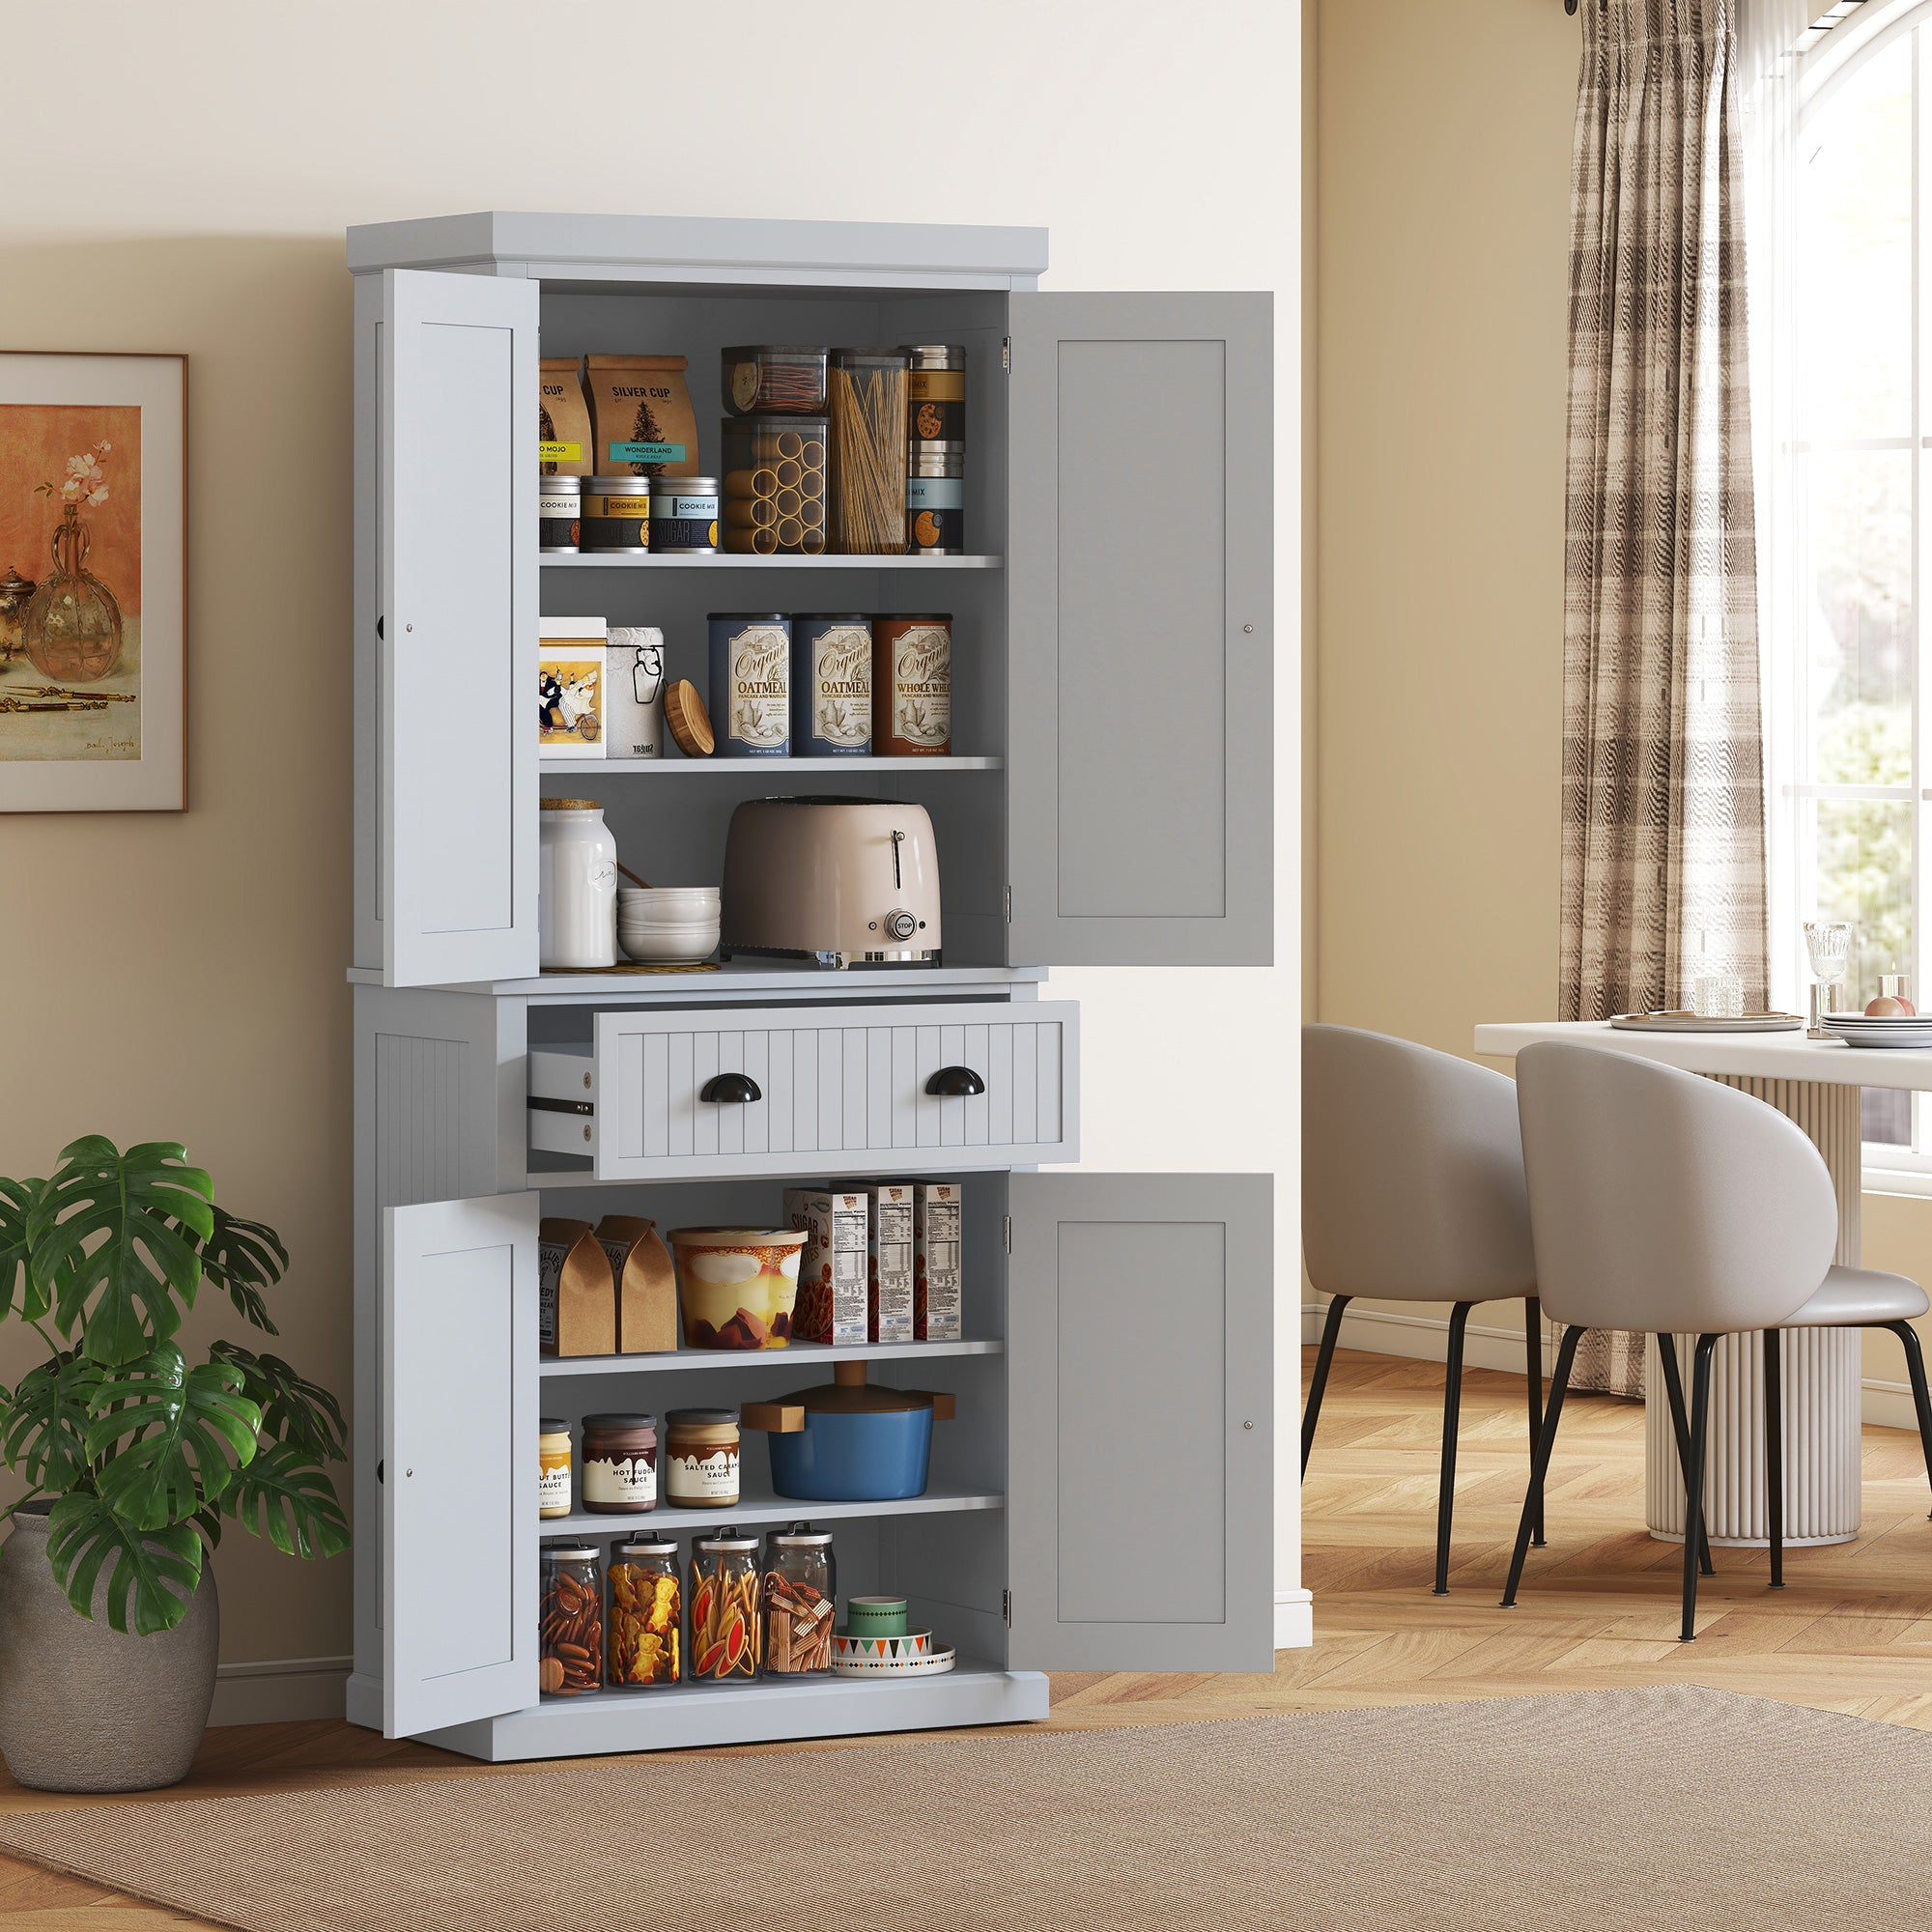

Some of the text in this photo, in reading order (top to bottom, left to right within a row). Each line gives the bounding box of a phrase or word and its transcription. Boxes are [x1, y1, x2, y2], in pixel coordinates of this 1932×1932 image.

[543, 385, 563, 395] CUP
[612, 386, 670, 398] SILVER CUP
[737, 681, 787, 694] OATMEAL
[821, 681, 870, 694] OATMEAL
[897, 683, 930, 693] WHOLE
